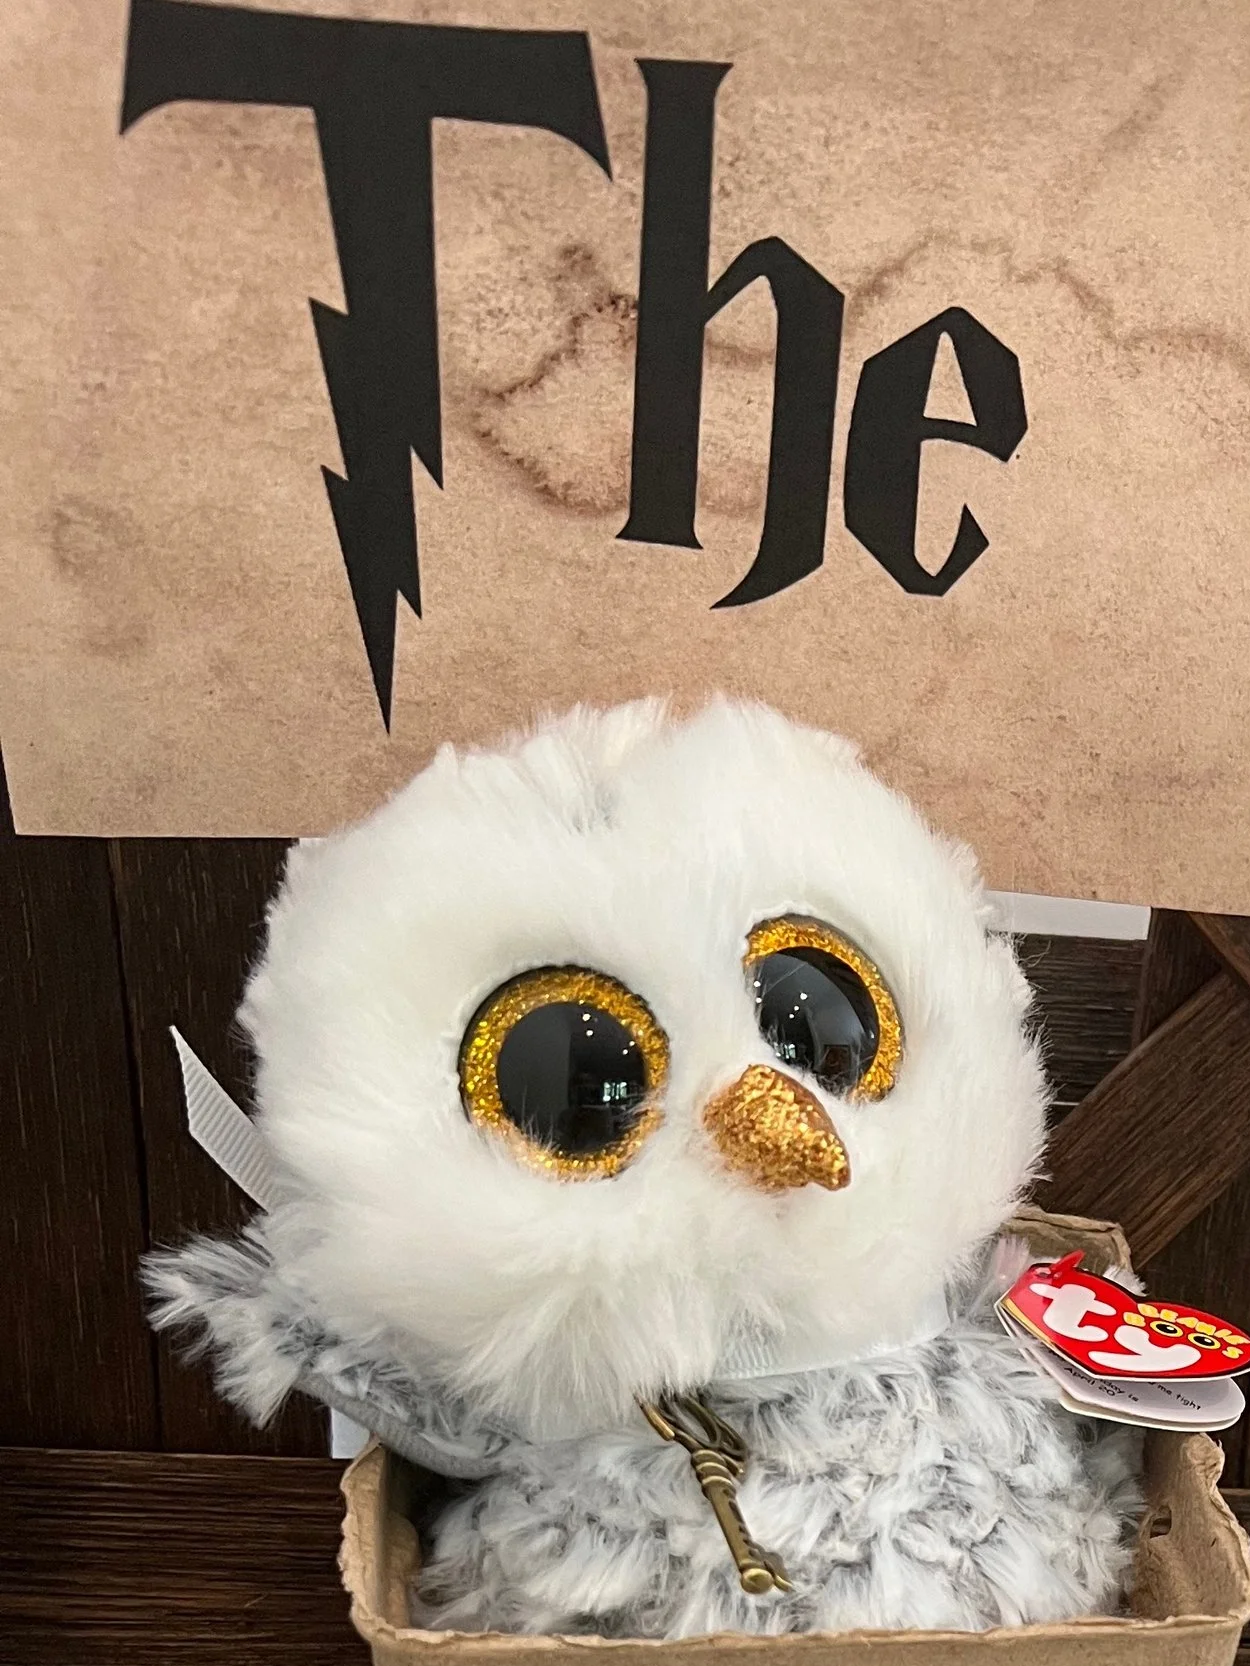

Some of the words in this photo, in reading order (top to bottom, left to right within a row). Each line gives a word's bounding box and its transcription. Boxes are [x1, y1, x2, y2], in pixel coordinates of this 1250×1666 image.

[120, 0, 1028, 734] The
[1029, 1283, 1201, 1372] ty
[1137, 1303, 1250, 1345] BEANIE
[1063, 1366, 1096, 1386] April
[1176, 1393, 1201, 1411] tight
